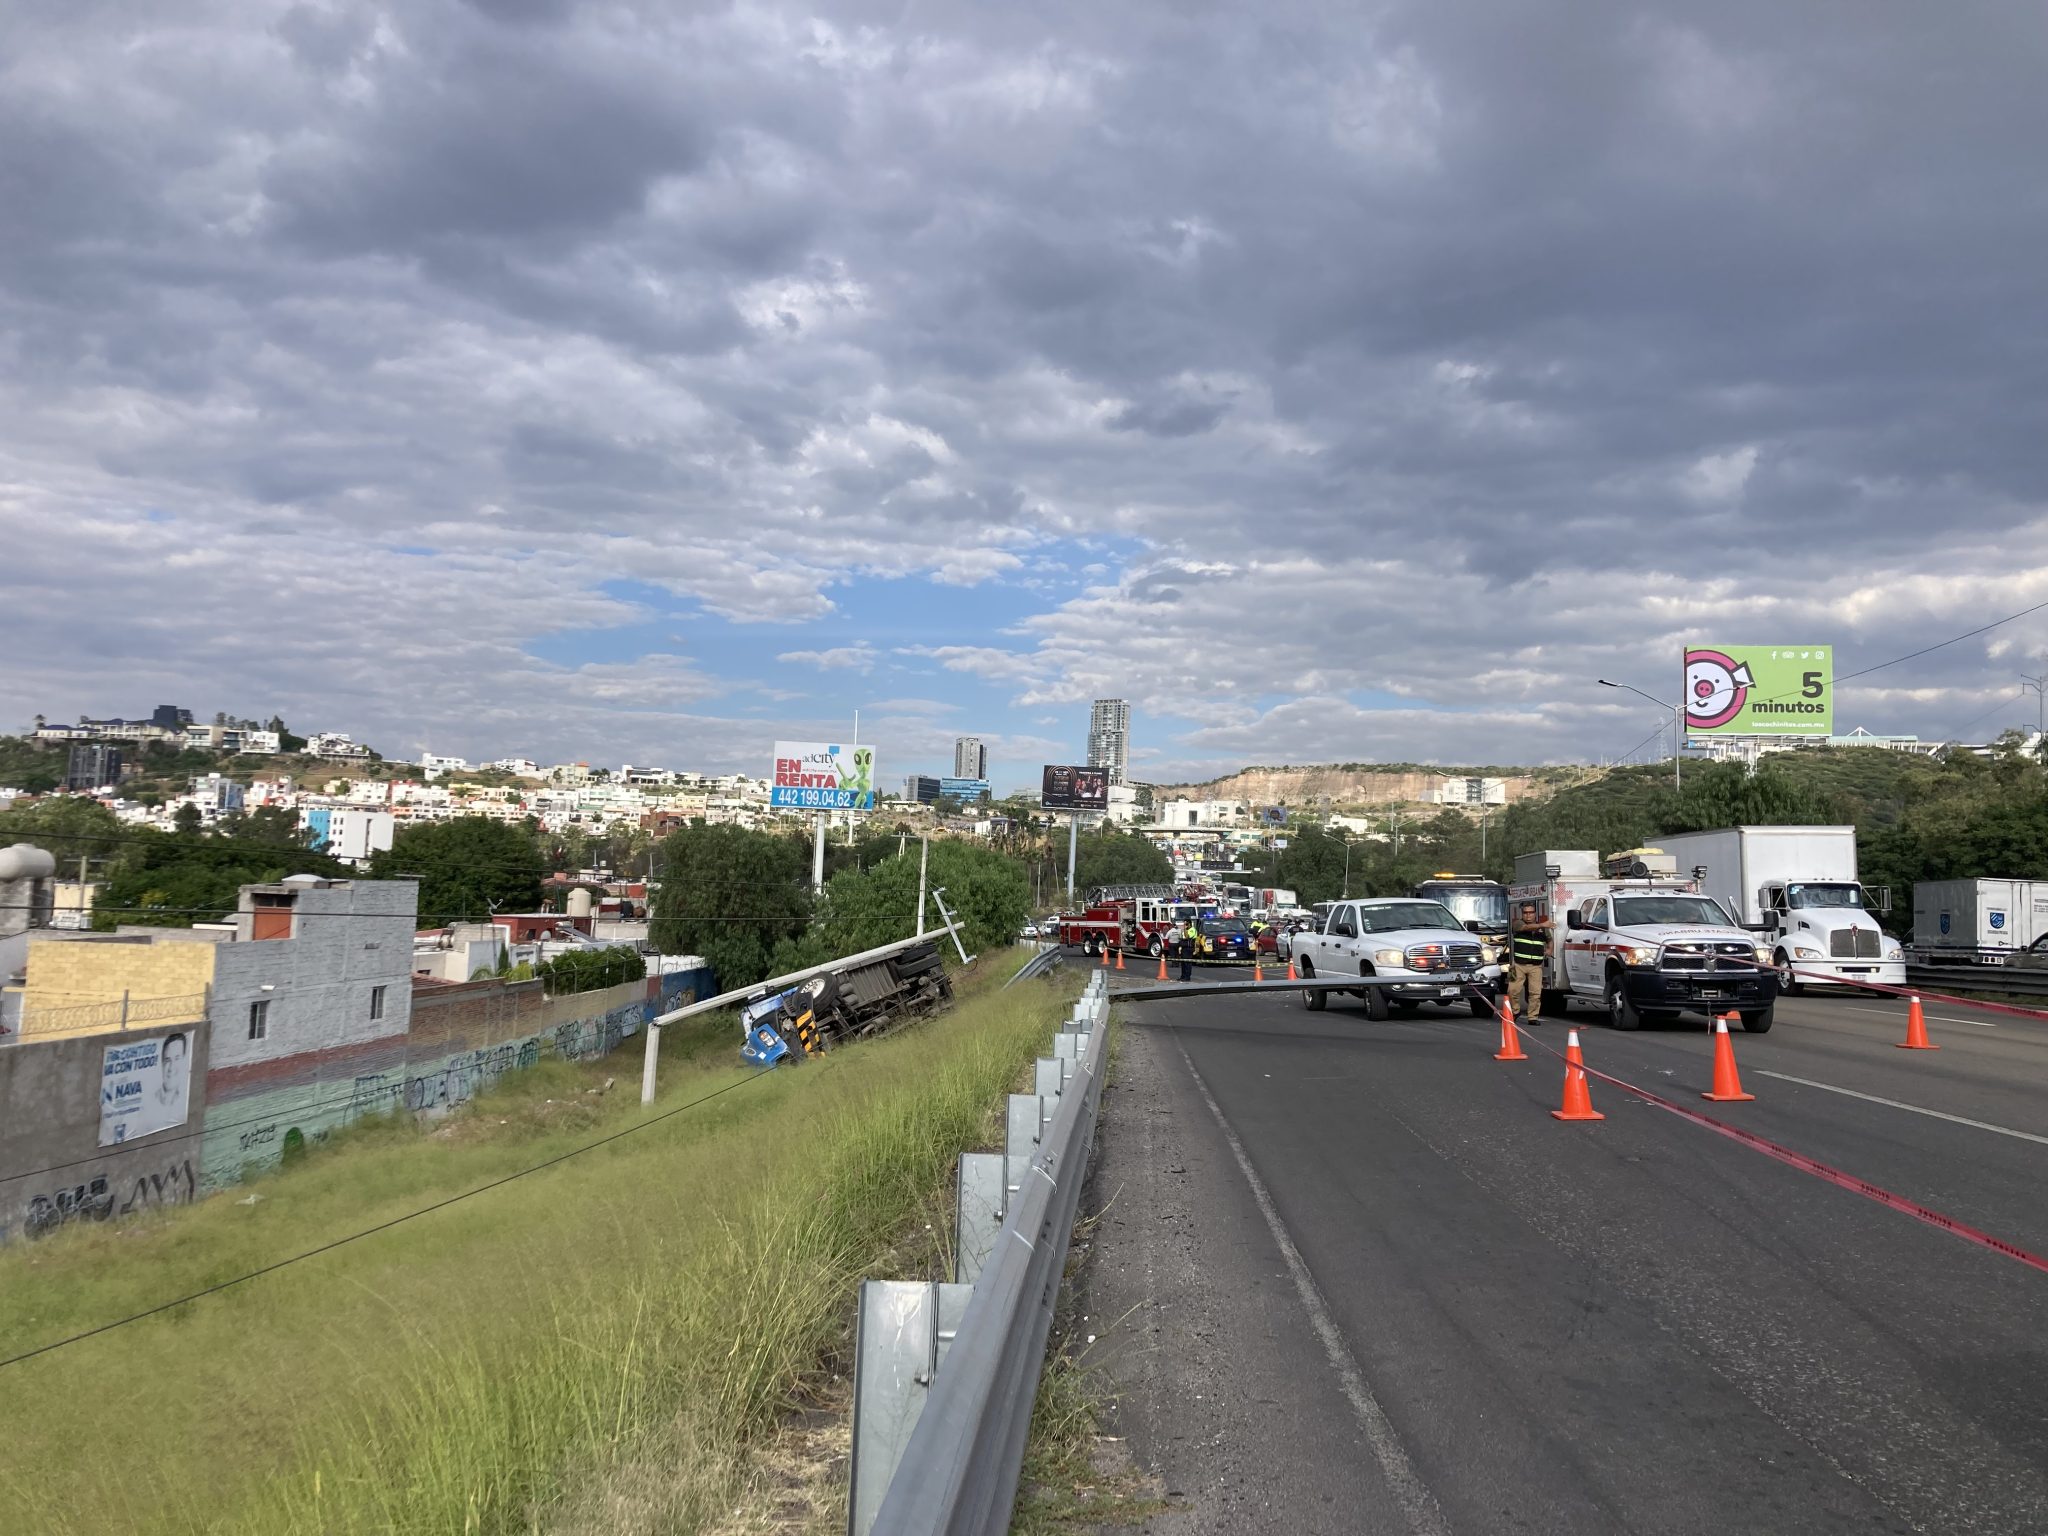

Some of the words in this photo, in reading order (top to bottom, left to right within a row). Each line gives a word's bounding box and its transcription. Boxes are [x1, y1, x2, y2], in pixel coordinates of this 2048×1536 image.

[1801, 671, 1823, 698] 5
[1752, 699, 1825, 713] minutos
[776, 758, 801, 773] EN
[775, 772, 837, 789] RENTA
[778, 789, 798, 804] 442
[801, 790, 850, 807] 199.04.62
[114, 1060, 132, 1074] CON
[115, 1080, 142, 1099] NAVA
